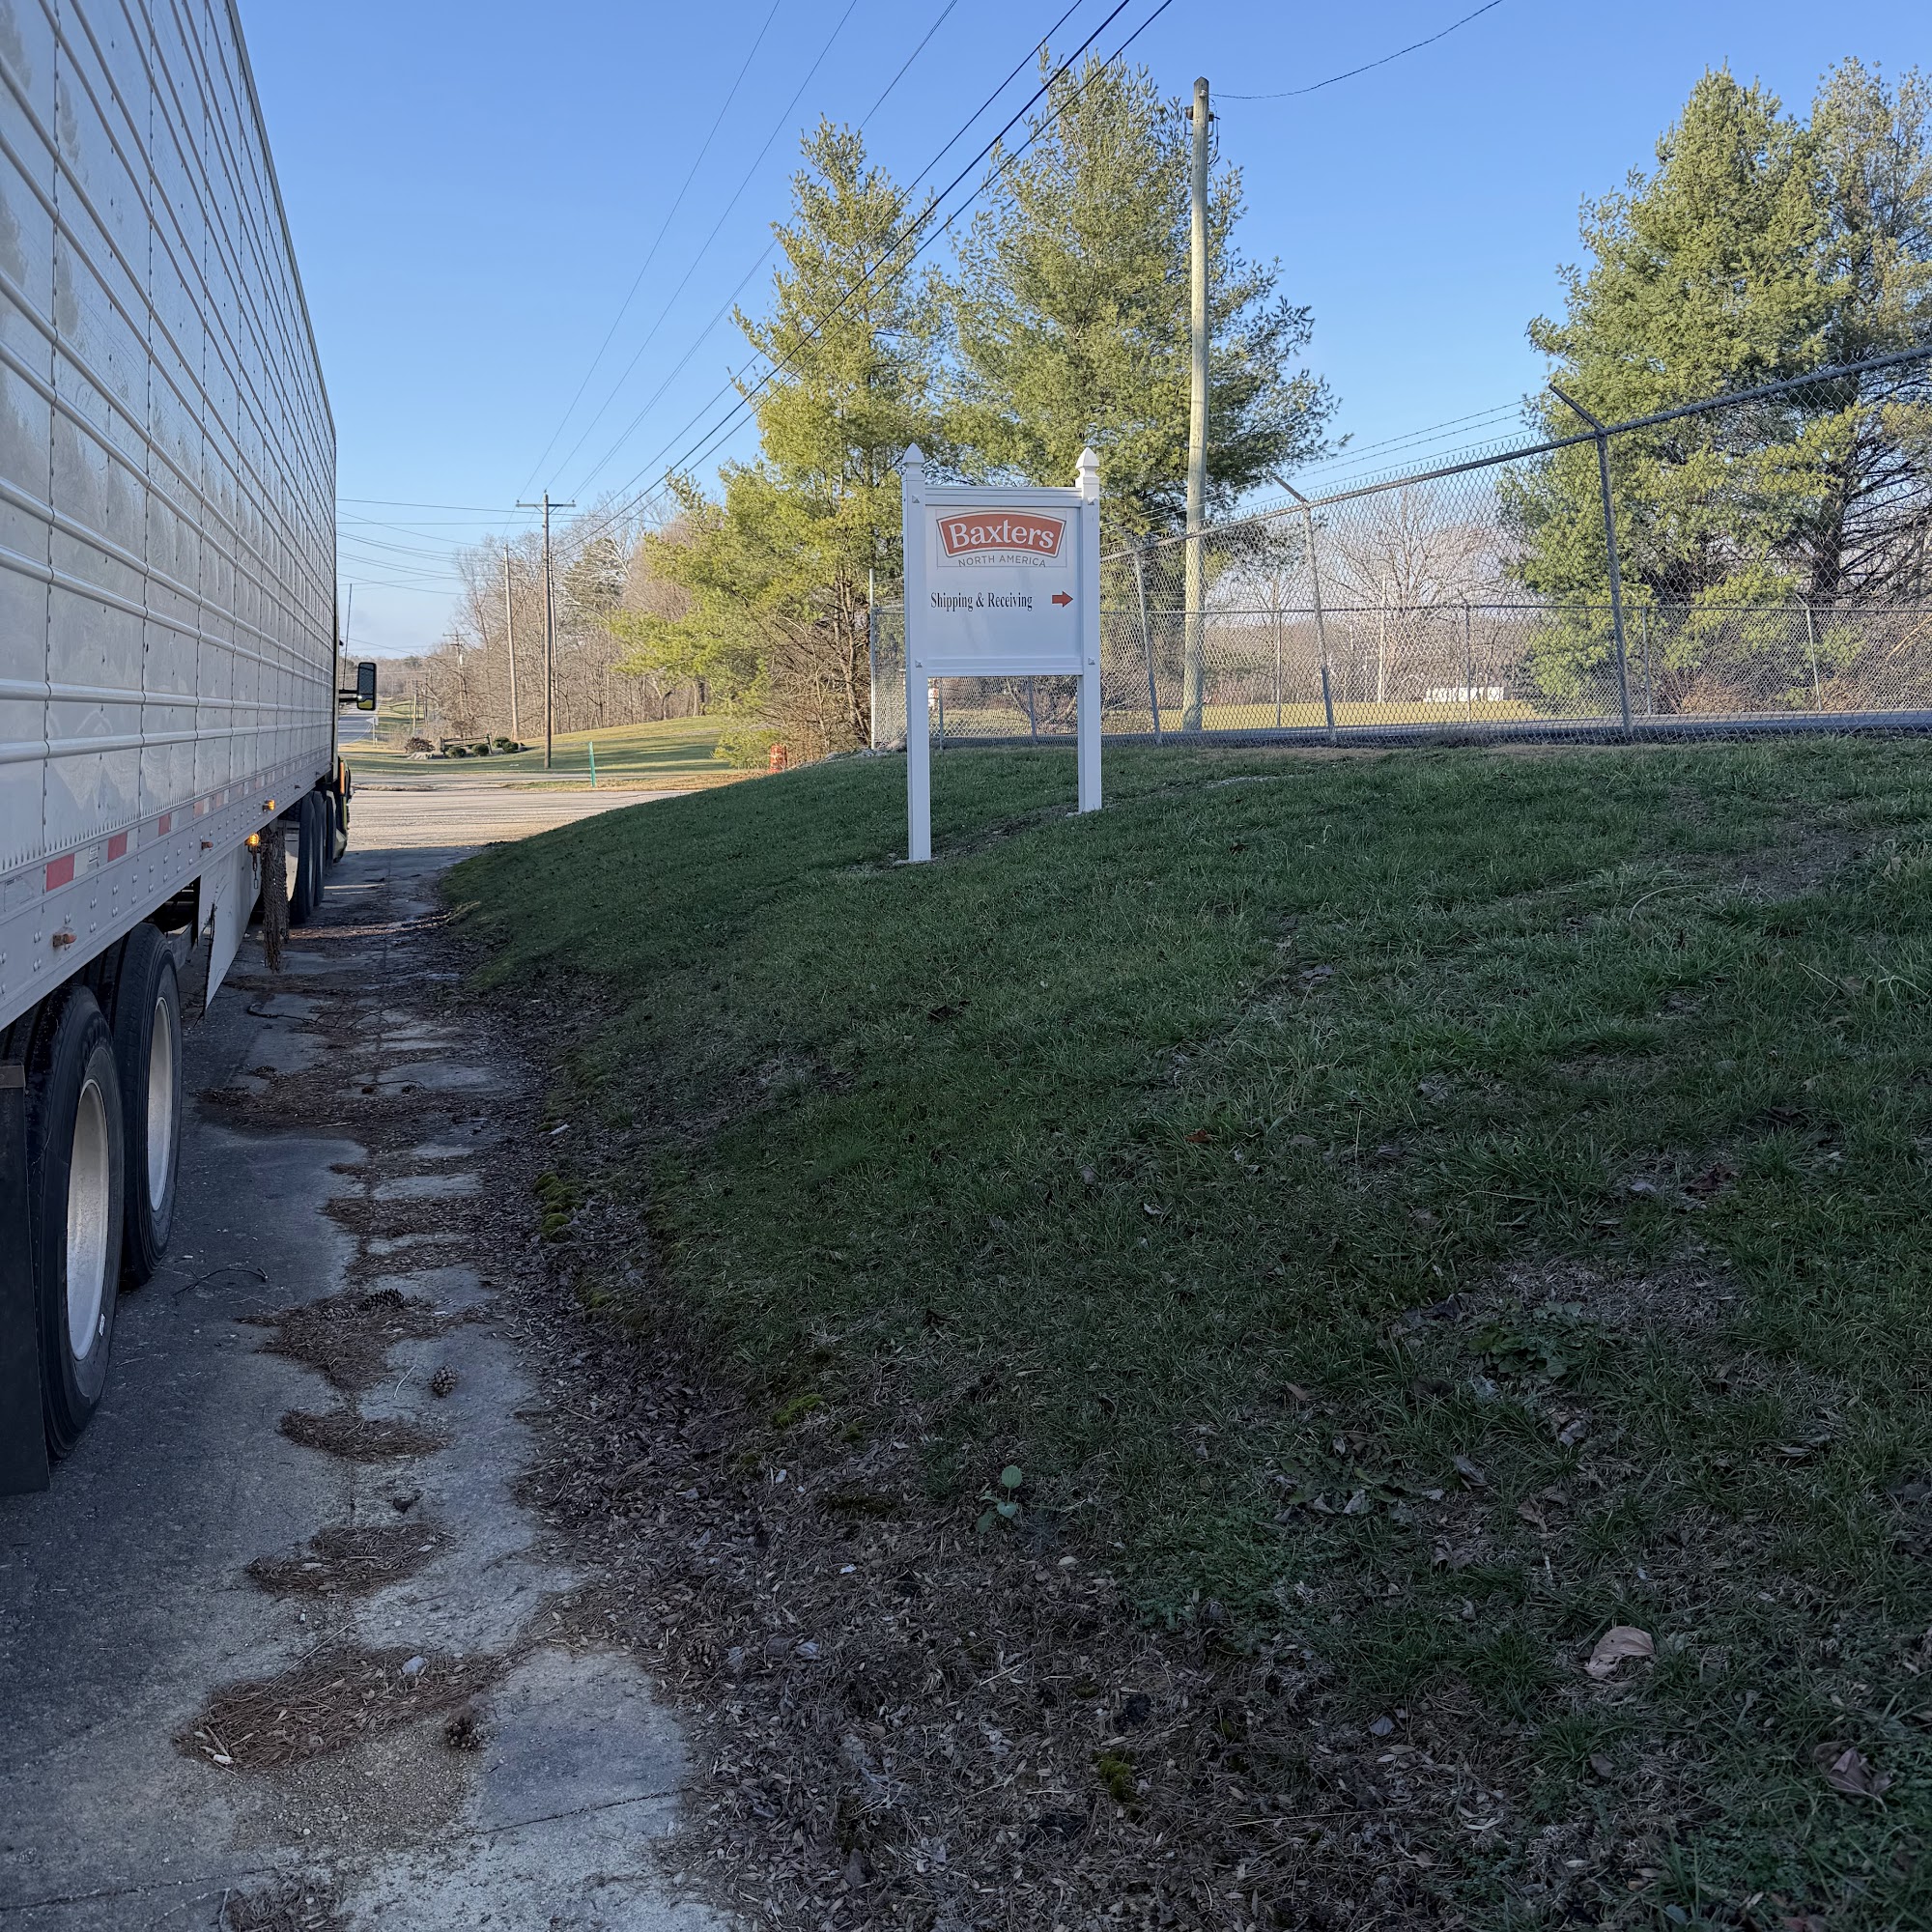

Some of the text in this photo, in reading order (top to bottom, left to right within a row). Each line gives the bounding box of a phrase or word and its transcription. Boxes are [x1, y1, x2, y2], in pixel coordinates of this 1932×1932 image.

[949, 520, 1054, 549] Baxters
[958, 555, 1046, 567] NORTH AMERICA
[931, 592, 1033, 611] Shipping & Receiving
